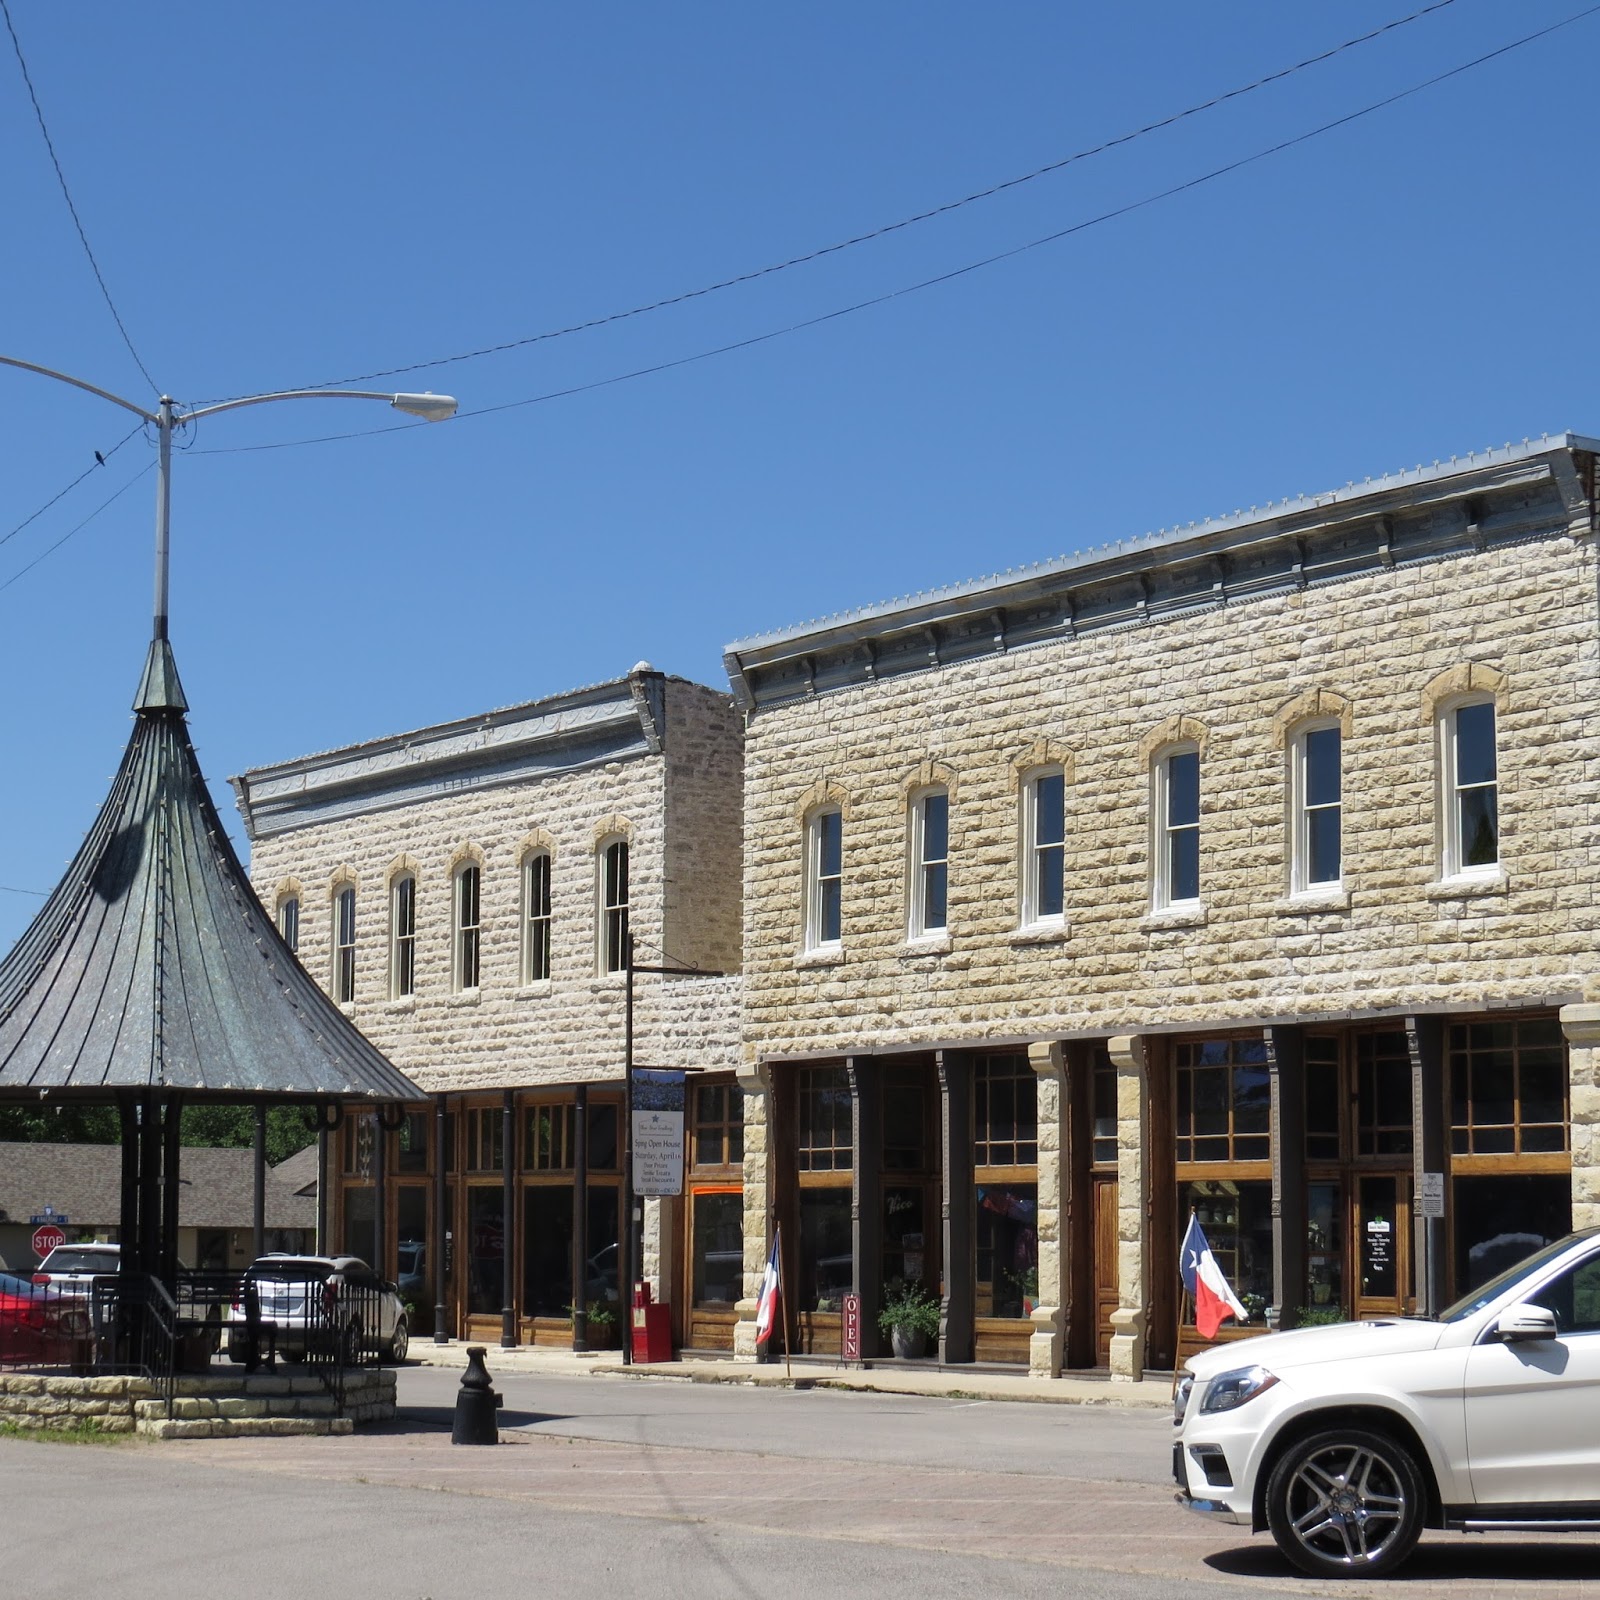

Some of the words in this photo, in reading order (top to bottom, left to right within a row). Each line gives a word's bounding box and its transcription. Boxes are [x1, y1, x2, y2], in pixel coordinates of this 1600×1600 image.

[648, 1139, 662, 1149] Open
[663, 1140, 680, 1148] House
[35, 1235, 63, 1248] STOP
[847, 1299, 857, 1353] OPEN
